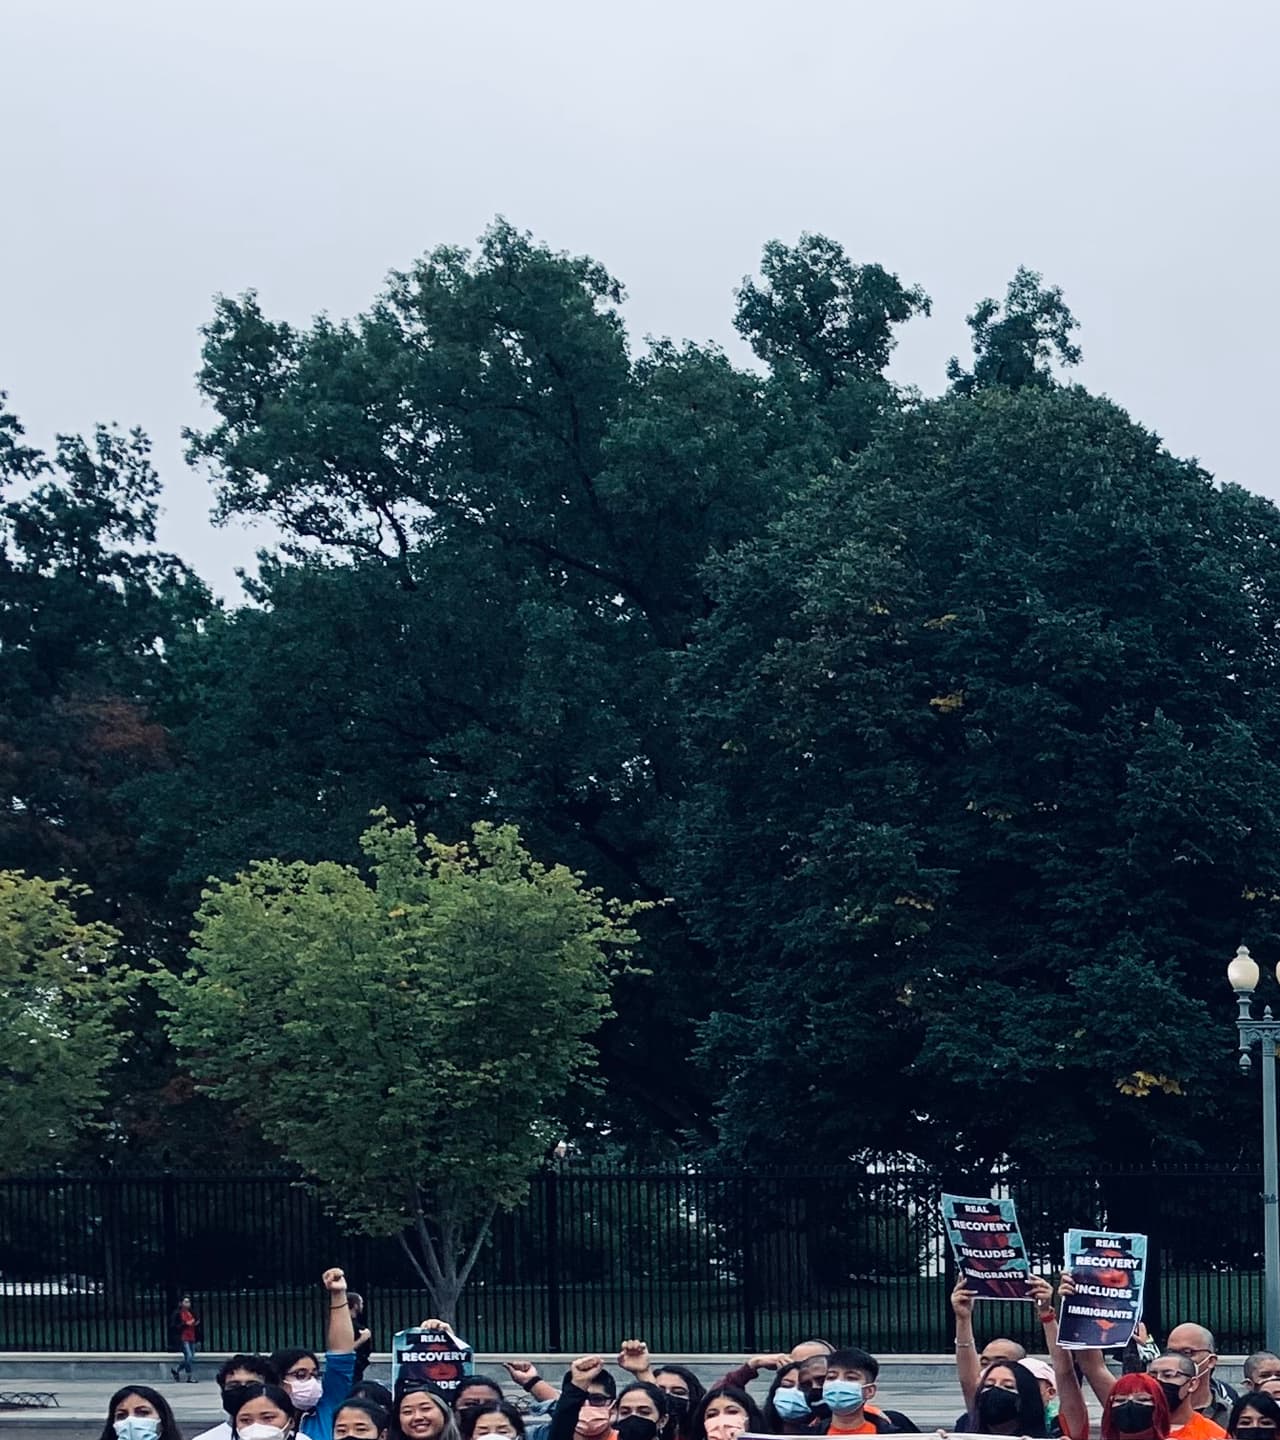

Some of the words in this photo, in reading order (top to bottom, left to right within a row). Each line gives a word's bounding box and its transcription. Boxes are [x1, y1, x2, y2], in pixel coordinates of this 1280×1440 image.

[965, 1205, 989, 1214] REAL
[952, 1220, 1011, 1232] RECOVERY
[1095, 1239, 1121, 1248] REAL
[962, 1248, 1015, 1258] INCLUDES
[1076, 1256, 1140, 1269] RECOVERY
[965, 1268, 1024, 1278] IMMIGRANTS
[1075, 1284, 1133, 1299] INCLUDES
[1068, 1306, 1133, 1320] IMMIGRANTS
[421, 1334, 447, 1342] REAL
[402, 1352, 467, 1362] RECOVERY
